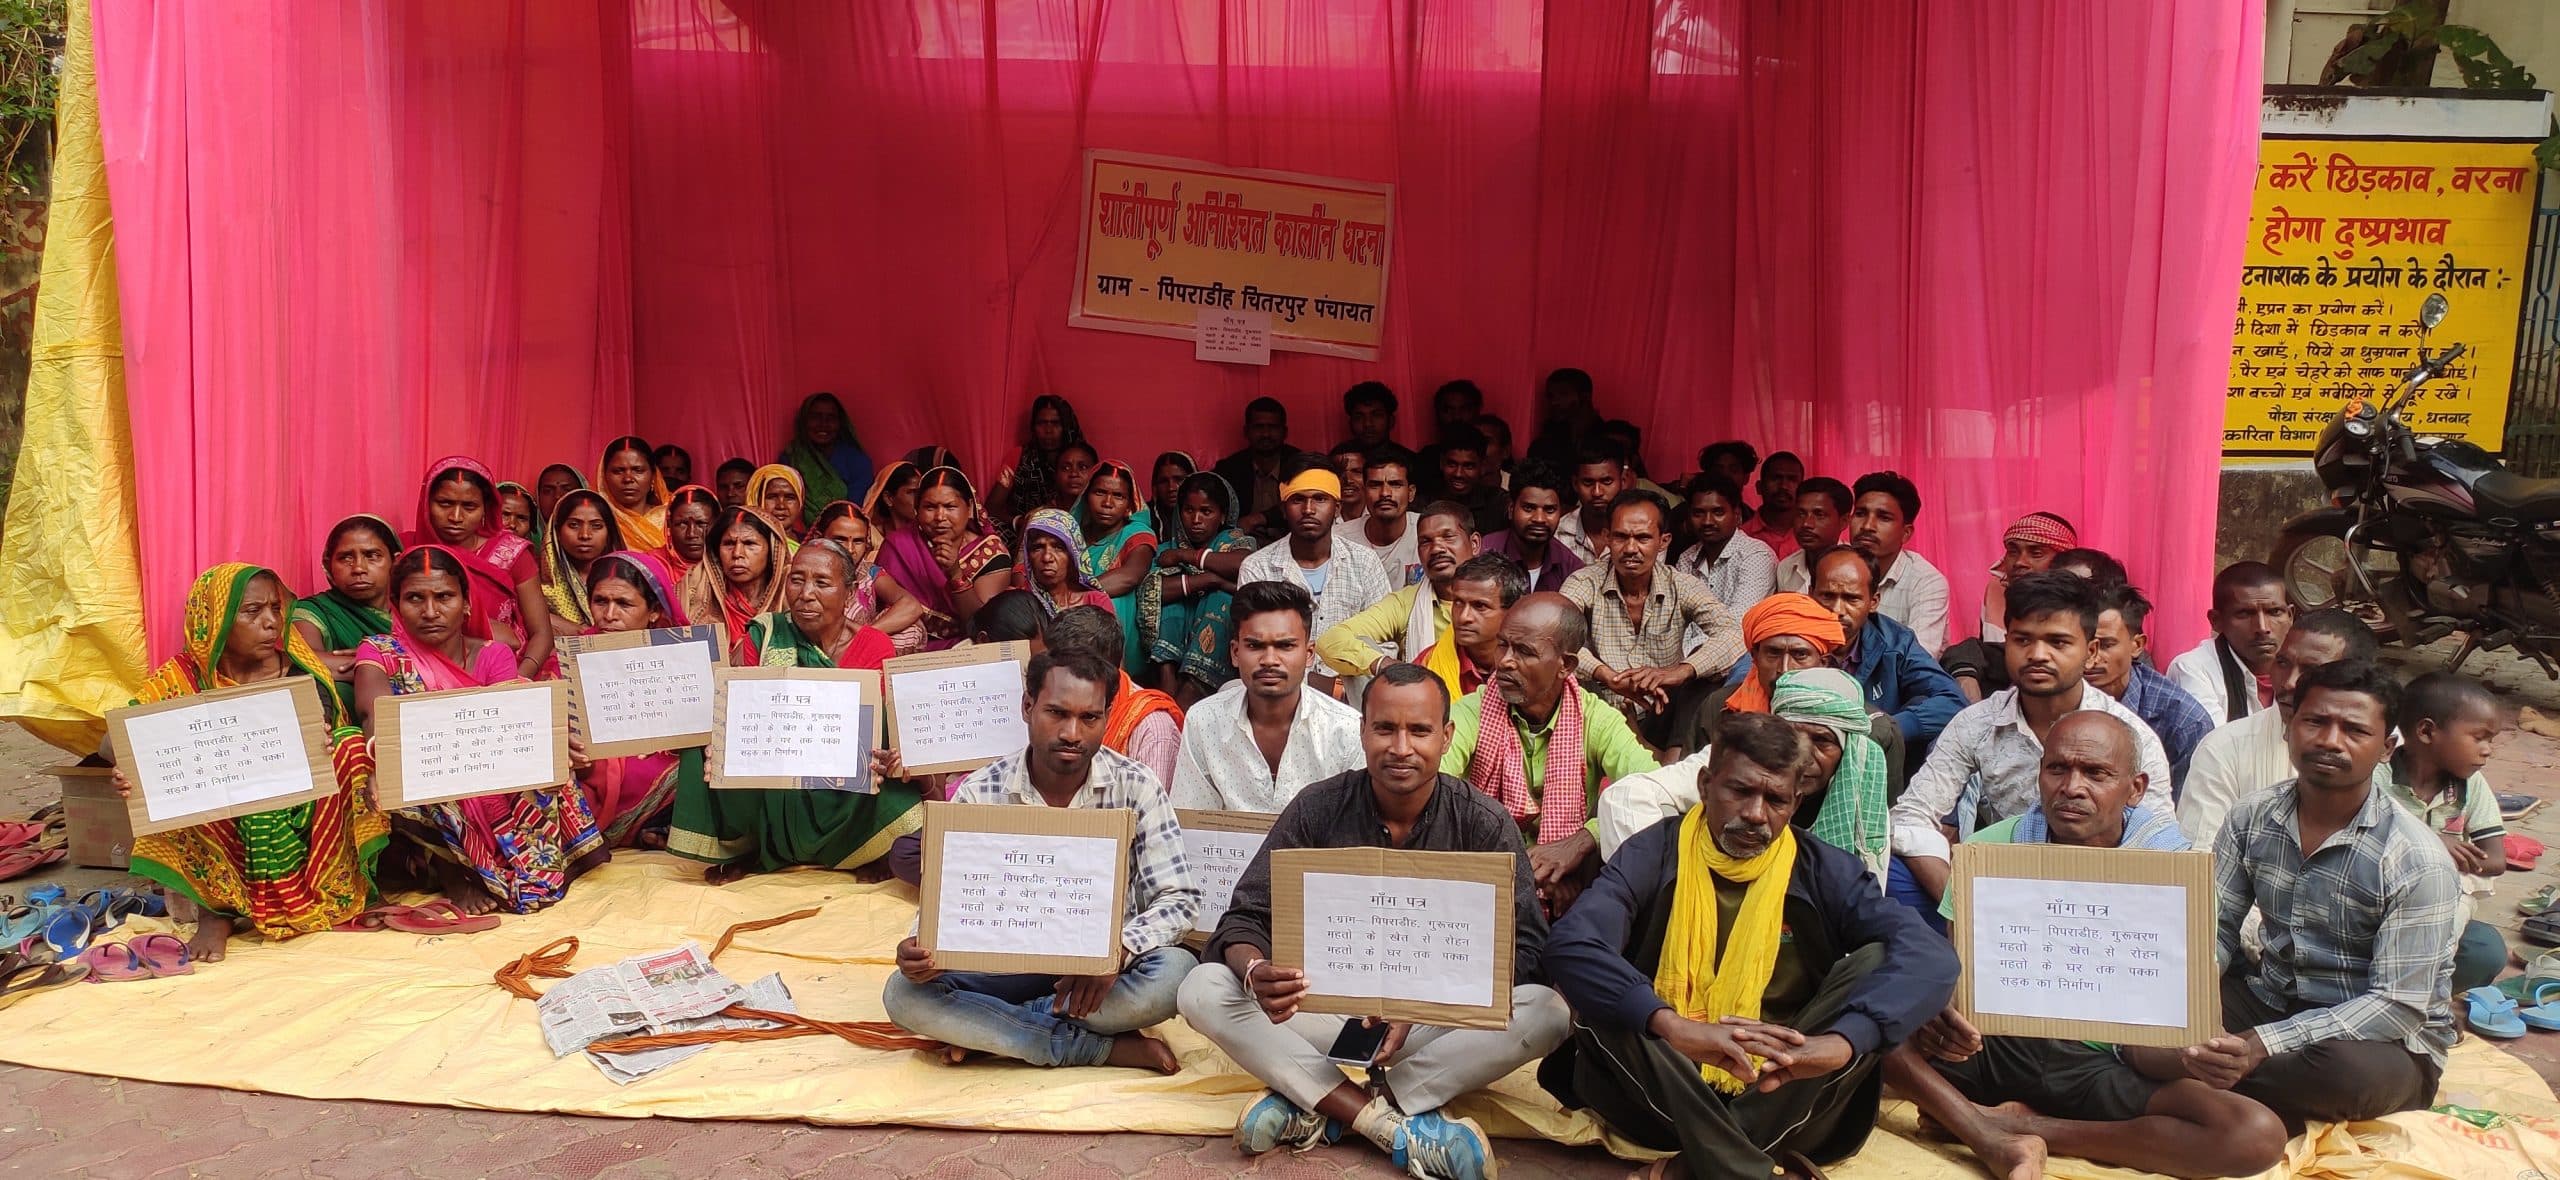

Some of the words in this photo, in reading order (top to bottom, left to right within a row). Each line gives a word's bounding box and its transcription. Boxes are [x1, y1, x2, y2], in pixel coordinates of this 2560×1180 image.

[2269, 152, 2317, 192] करें
[2451, 166, 2530, 194] वरना
[1274, 203, 1340, 262] कालीन
[2262, 206, 2326, 255] होगा
[2333, 218, 2451, 260] दुष्प्रभाव
[2316, 256, 2337, 287] के
[2344, 256, 2403, 288] प्रयोग
[2408, 257, 2428, 288] के
[2433, 253, 2490, 291] दौरान
[1097, 274, 1133, 297] ग्राम
[1157, 276, 1235, 310] पिपराडीह
[1241, 286, 1308, 323] चितरपुर
[1315, 294, 1375, 324] पंचायत
[2256, 303, 2286, 316] एप्रन
[2292, 303, 2313, 314] का
[2317, 298, 2356, 315] प्रयोग
[2251, 318, 2281, 337] दिशा
[2286, 318, 2299, 335] में
[2309, 318, 2371, 341] छिड़काव
[2378, 325, 2392, 337] न
[2340, 347, 2356, 357] या
[2239, 359, 2261, 378] पैर
[2266, 362, 2288, 379] एवं
[2295, 360, 2331, 383] चेहरे
[2333, 361, 2352, 378] को
[2357, 367, 2385, 378] साफ
[2249, 382, 2286, 399] बच्चों
[2291, 383, 2312, 400] एवं
[2268, 404, 2297, 422] पौधा
[2302, 408, 2338, 424] संरक्ष
[2279, 425, 2318, 441] विभाग
[1036, 854, 1054, 865] पत्र
[1406, 897, 1426, 910] पत्र
[2084, 904, 2109, 917] पत्र
[1365, 930, 1376, 940] के
[1365, 945, 1374, 956] के
[1999, 939, 2027, 952] महतो
[2042, 941, 2054, 953] के
[2068, 943, 2089, 955] खेत
[2105, 944, 2115, 957] से
[2129, 946, 2158, 960] रोहन
[1359, 963, 1373, 972] का
[2000, 957, 2028, 970] महतो
[2040, 958, 2052, 971] के
[2065, 963, 2083, 973] घर
[2095, 965, 2115, 974] तक
[2129, 967, 2159, 977] पक्का
[1999, 976, 2029, 988] सड़क
[2035, 978, 2051, 988] का
